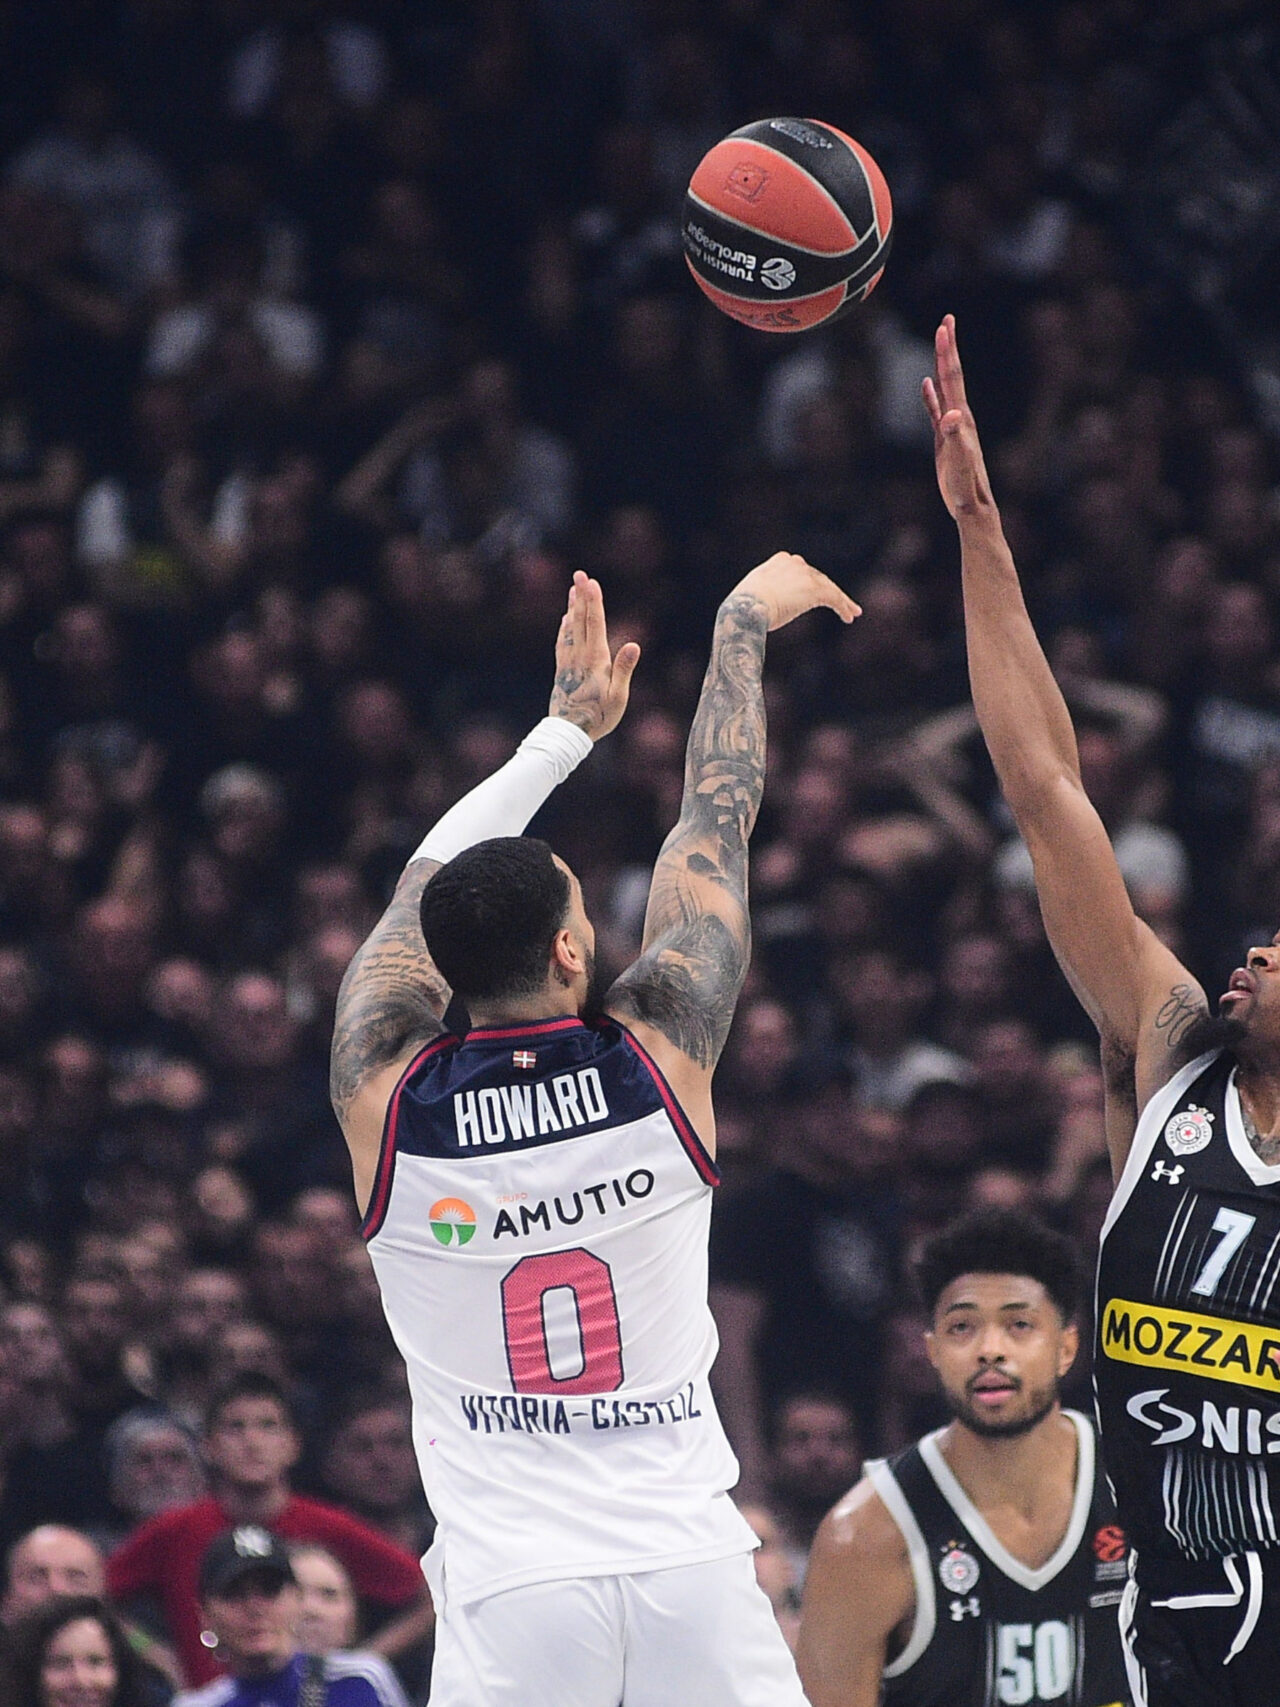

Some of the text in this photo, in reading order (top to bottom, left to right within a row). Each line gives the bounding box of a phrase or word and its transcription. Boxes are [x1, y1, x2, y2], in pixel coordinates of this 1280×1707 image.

[453, 1066, 610, 1147] HOWARD
[493, 1168, 655, 1239] AMUTIO
[1190, 1206, 1257, 1297] 7
[499, 1246, 626, 1395] 0
[996, 1619, 1073, 1706] 50
